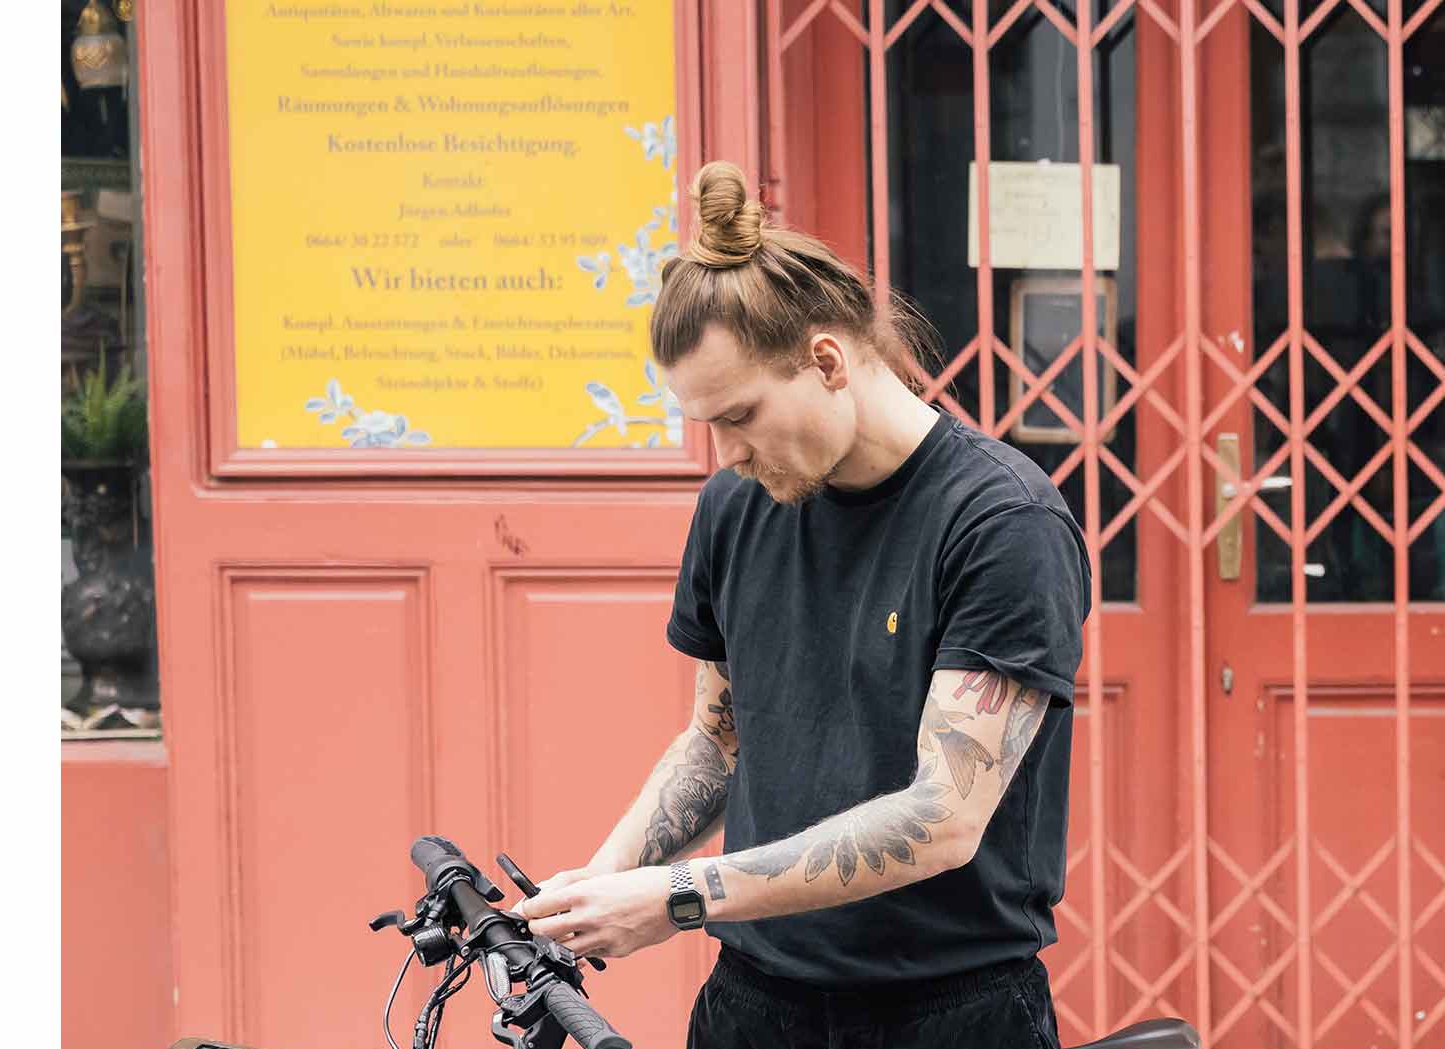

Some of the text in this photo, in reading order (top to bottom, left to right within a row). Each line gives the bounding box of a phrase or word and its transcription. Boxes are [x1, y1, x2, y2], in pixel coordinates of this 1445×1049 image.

[441, 4, 469, 17] und
[277, 95, 389, 118] Räumungen
[394, 96, 412, 113] &
[326, 133, 438, 154] Kostenlose
[350, 265, 564, 291] Wir bieten auch:
[452, 316, 465, 329] &
